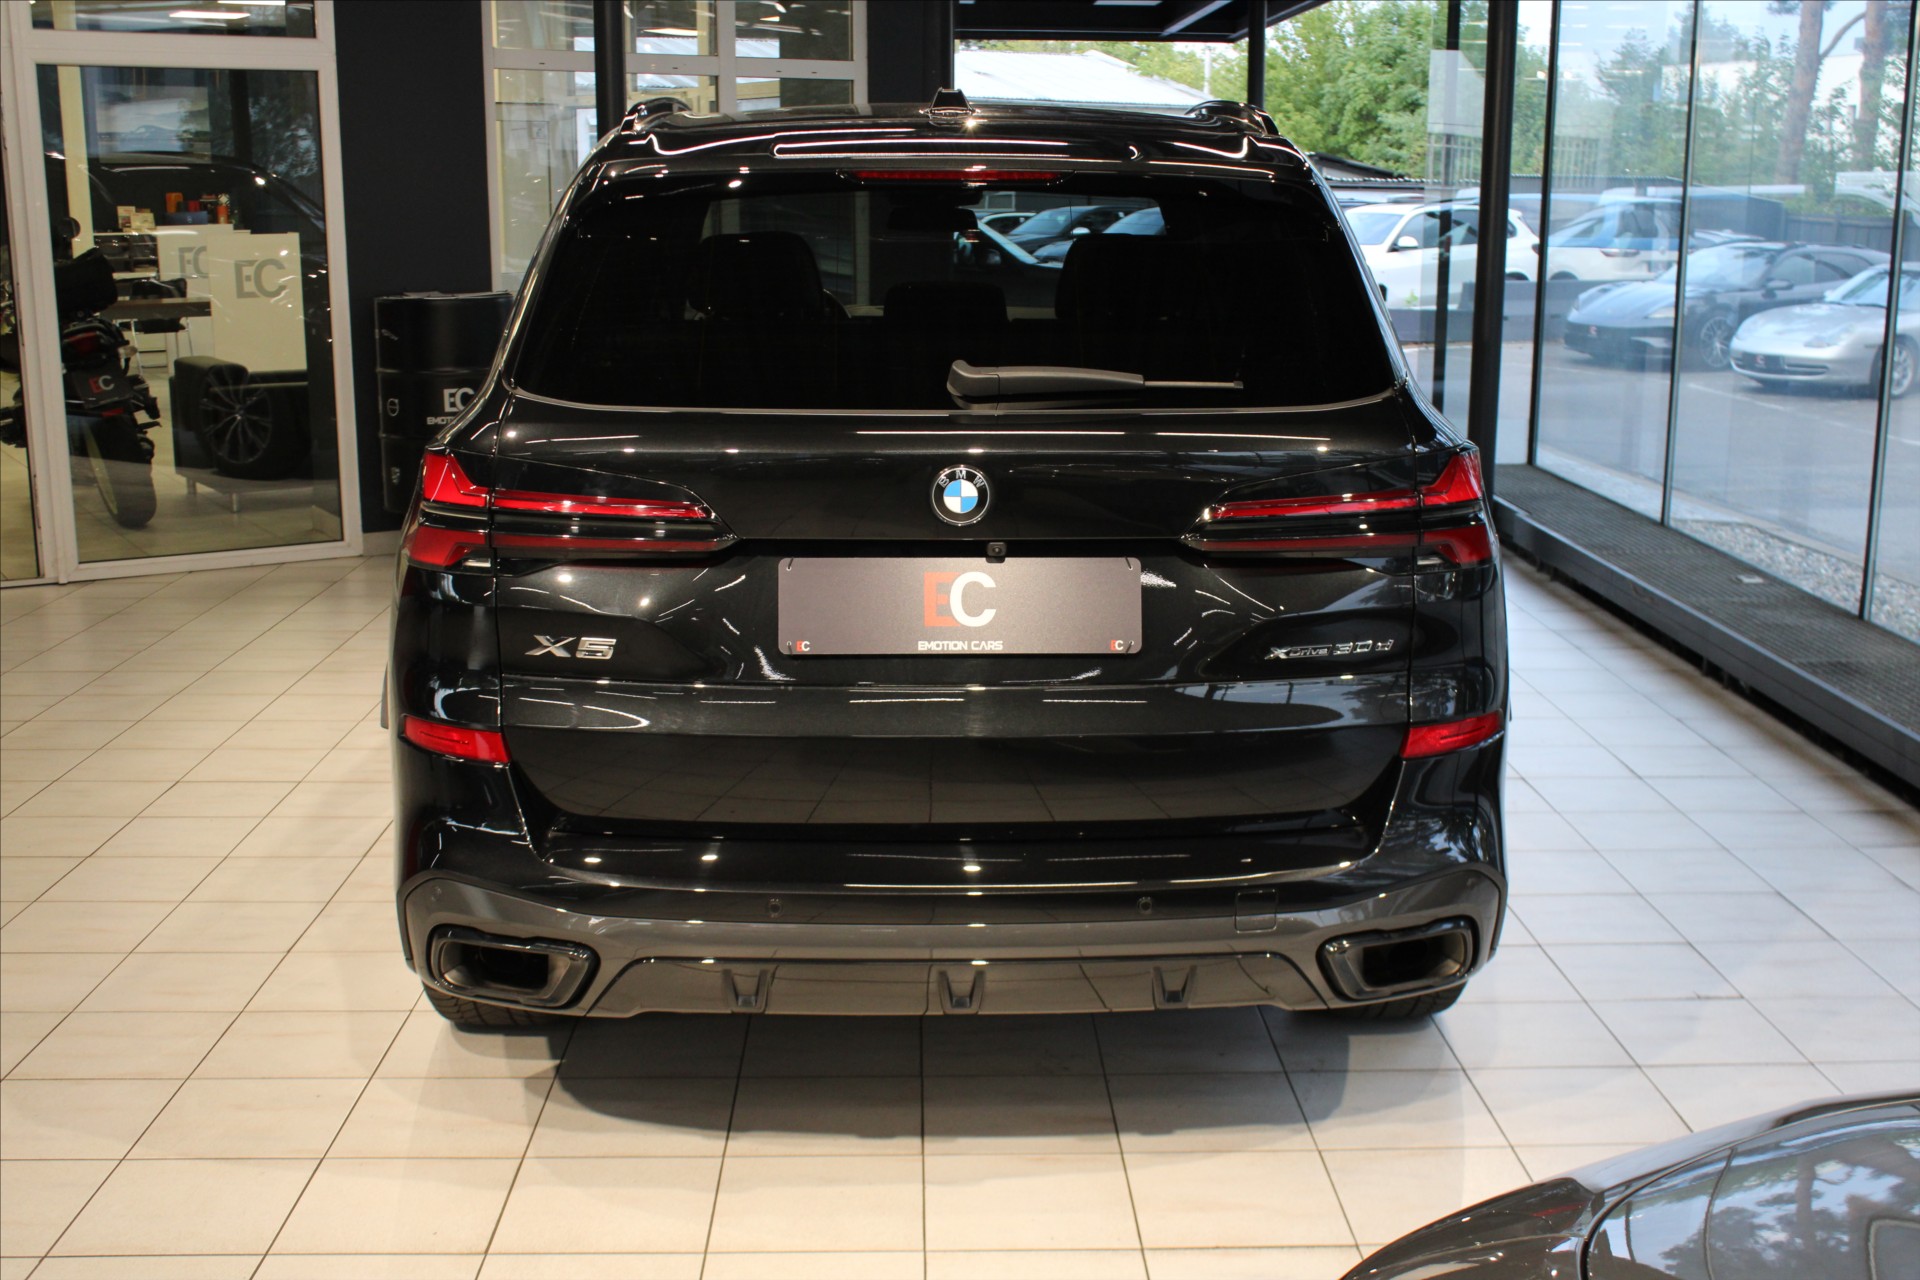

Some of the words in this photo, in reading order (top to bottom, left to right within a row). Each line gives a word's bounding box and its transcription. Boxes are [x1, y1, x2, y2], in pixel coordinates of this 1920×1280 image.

[235, 259, 288, 299] EC
[89, 375, 115, 393] EC
[443, 387, 475, 412] EC
[938, 469, 985, 489] BMW
[923, 571, 997, 628] EC
[524, 634, 617, 660] X5
[796, 640, 811, 652] EC
[917, 640, 968, 651] EMOTION
[971, 640, 1003, 651] CARS
[1110, 640, 1124, 651] EC
